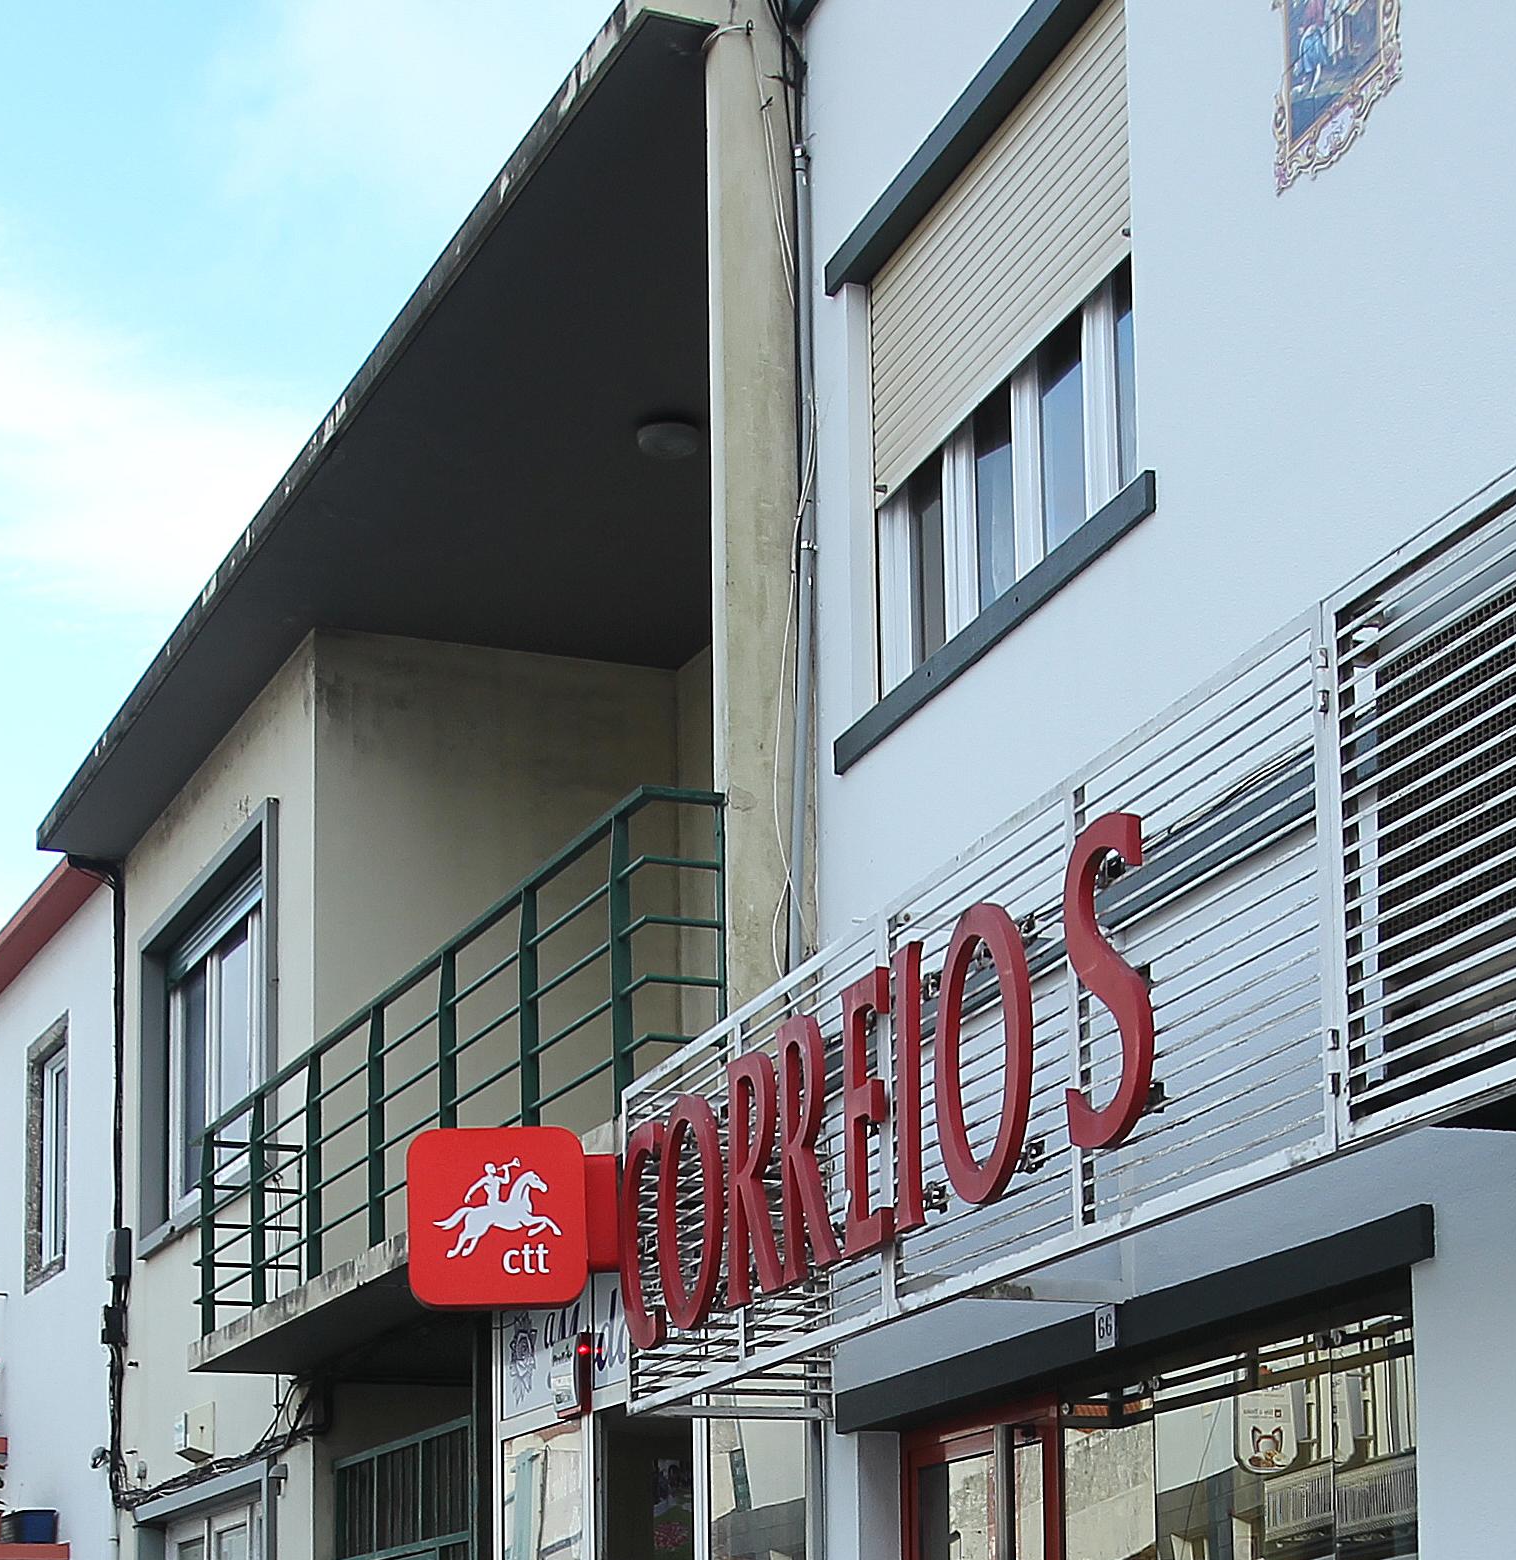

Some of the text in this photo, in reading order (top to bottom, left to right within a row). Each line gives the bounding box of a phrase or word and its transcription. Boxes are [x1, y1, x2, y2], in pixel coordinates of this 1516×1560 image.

[620, 812, 1154, 1350] CORREIOS
[502, 1243, 550, 1274] ctt
[1098, 1313, 1112, 1339] 66
